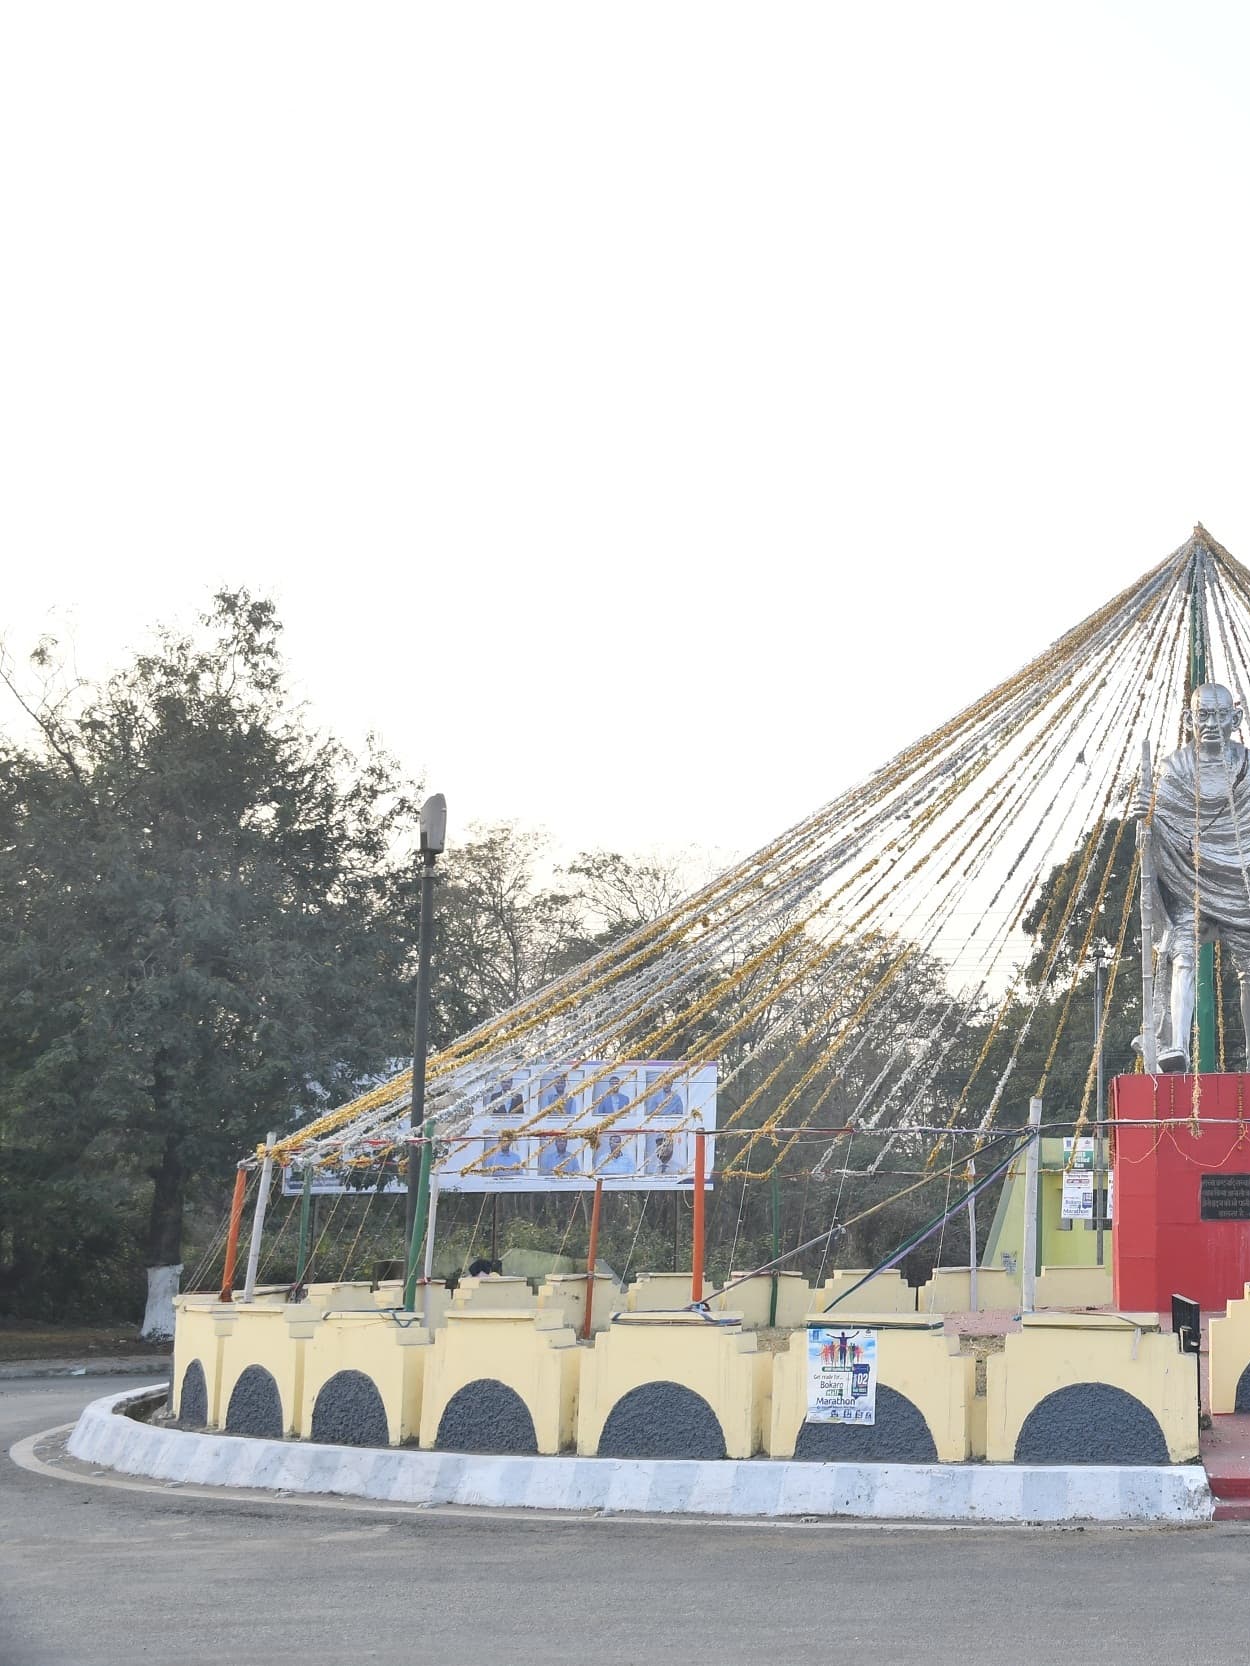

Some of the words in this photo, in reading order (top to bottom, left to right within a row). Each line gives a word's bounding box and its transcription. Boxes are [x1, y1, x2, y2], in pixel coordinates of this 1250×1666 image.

[858, 1373, 868, 1384] 02
[820, 1380, 844, 1389] Bokaro
[816, 1397, 856, 1405] Marathon
